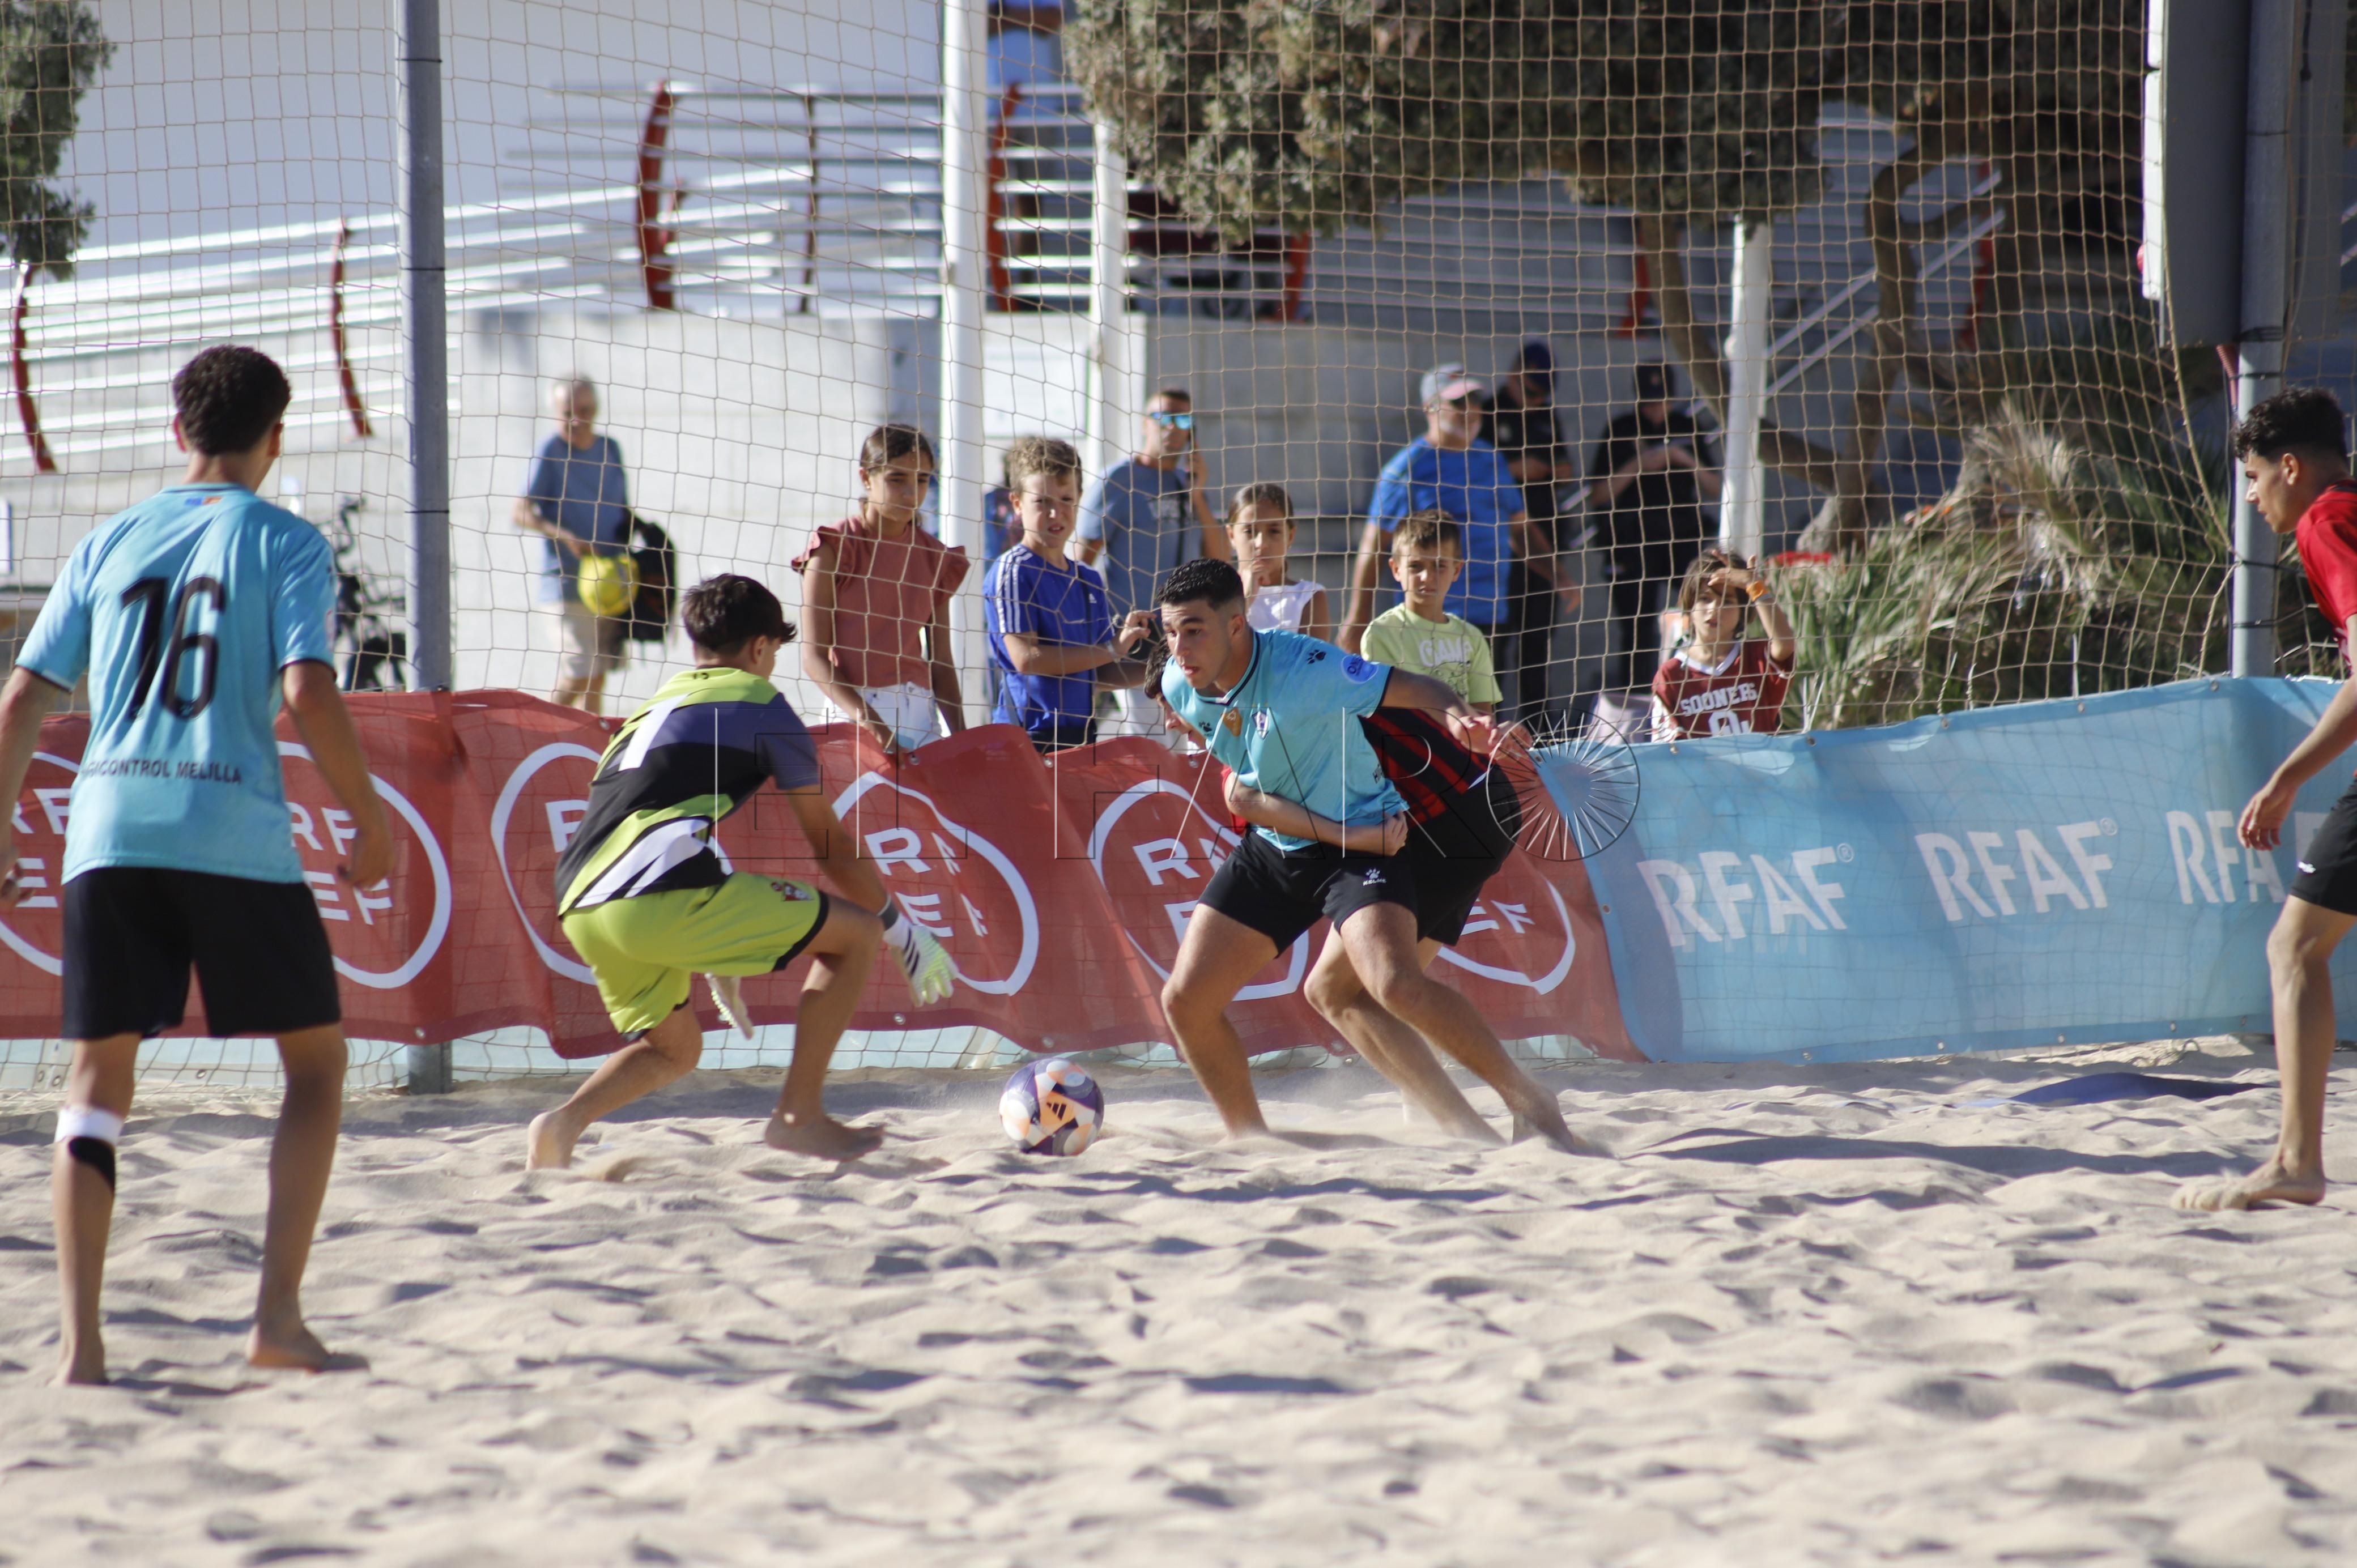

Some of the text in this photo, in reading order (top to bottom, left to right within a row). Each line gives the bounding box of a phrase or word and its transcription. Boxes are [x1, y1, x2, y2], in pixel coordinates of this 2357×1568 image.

[119, 576, 226, 721] 16
[176, 761, 242, 785] MELILLA
[286, 802, 358, 856] RF
